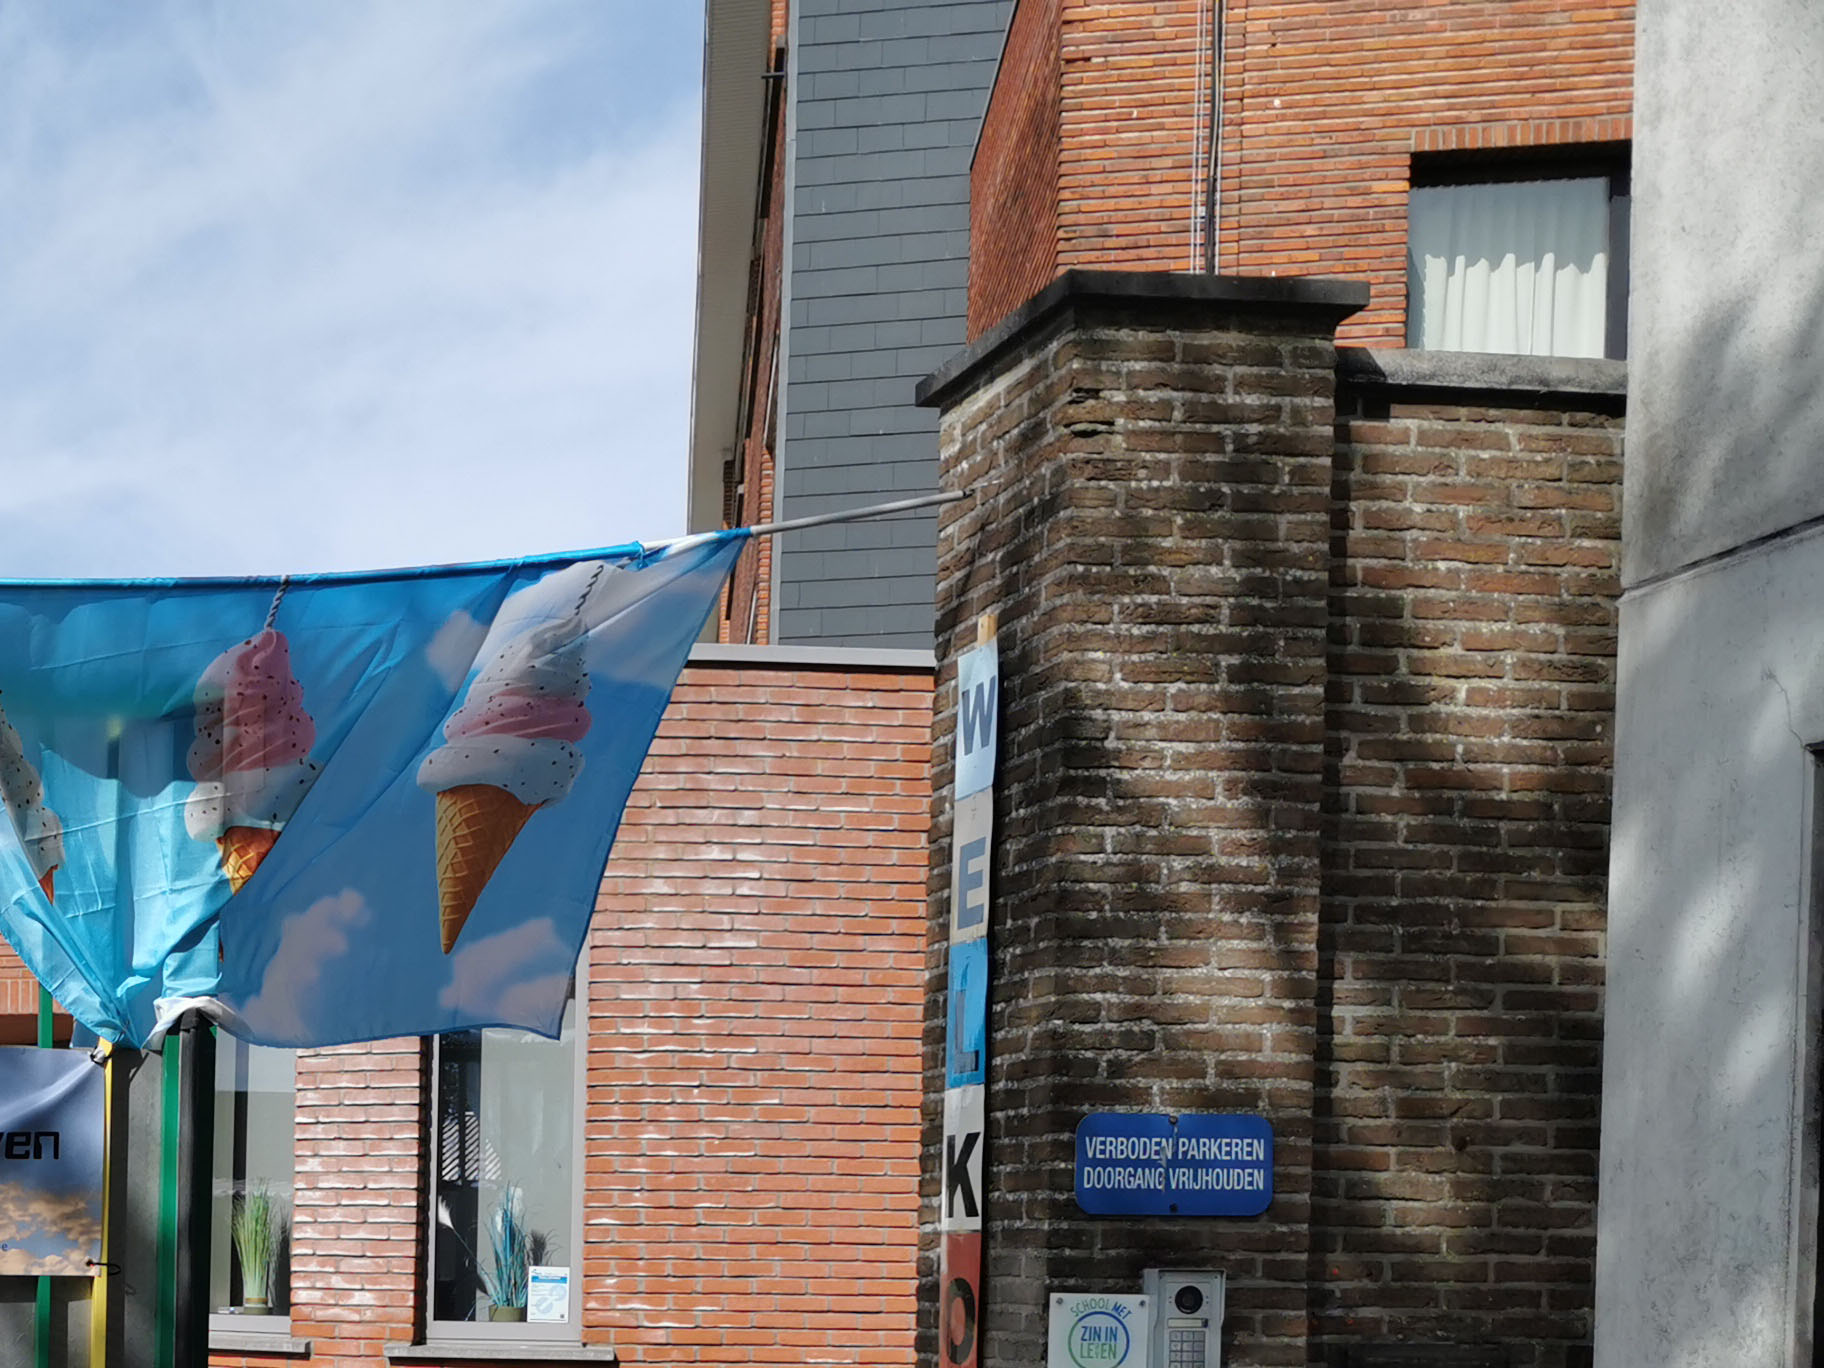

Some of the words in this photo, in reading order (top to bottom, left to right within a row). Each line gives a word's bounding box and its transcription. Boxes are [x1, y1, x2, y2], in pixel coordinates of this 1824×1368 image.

[1085, 1136, 1173, 1159] VERBODEN
[1178, 1138, 1264, 1161] PARKEREN
[1083, 1167, 1166, 1189] DOORGANG
[1169, 1168, 1264, 1190] VRIJHOUDEN
[1070, 1298, 1110, 1317] SCHOOL
[1111, 1301, 1133, 1320] MET
[1081, 1326, 1101, 1342] ZIN
[1105, 1326, 1118, 1342] IN
